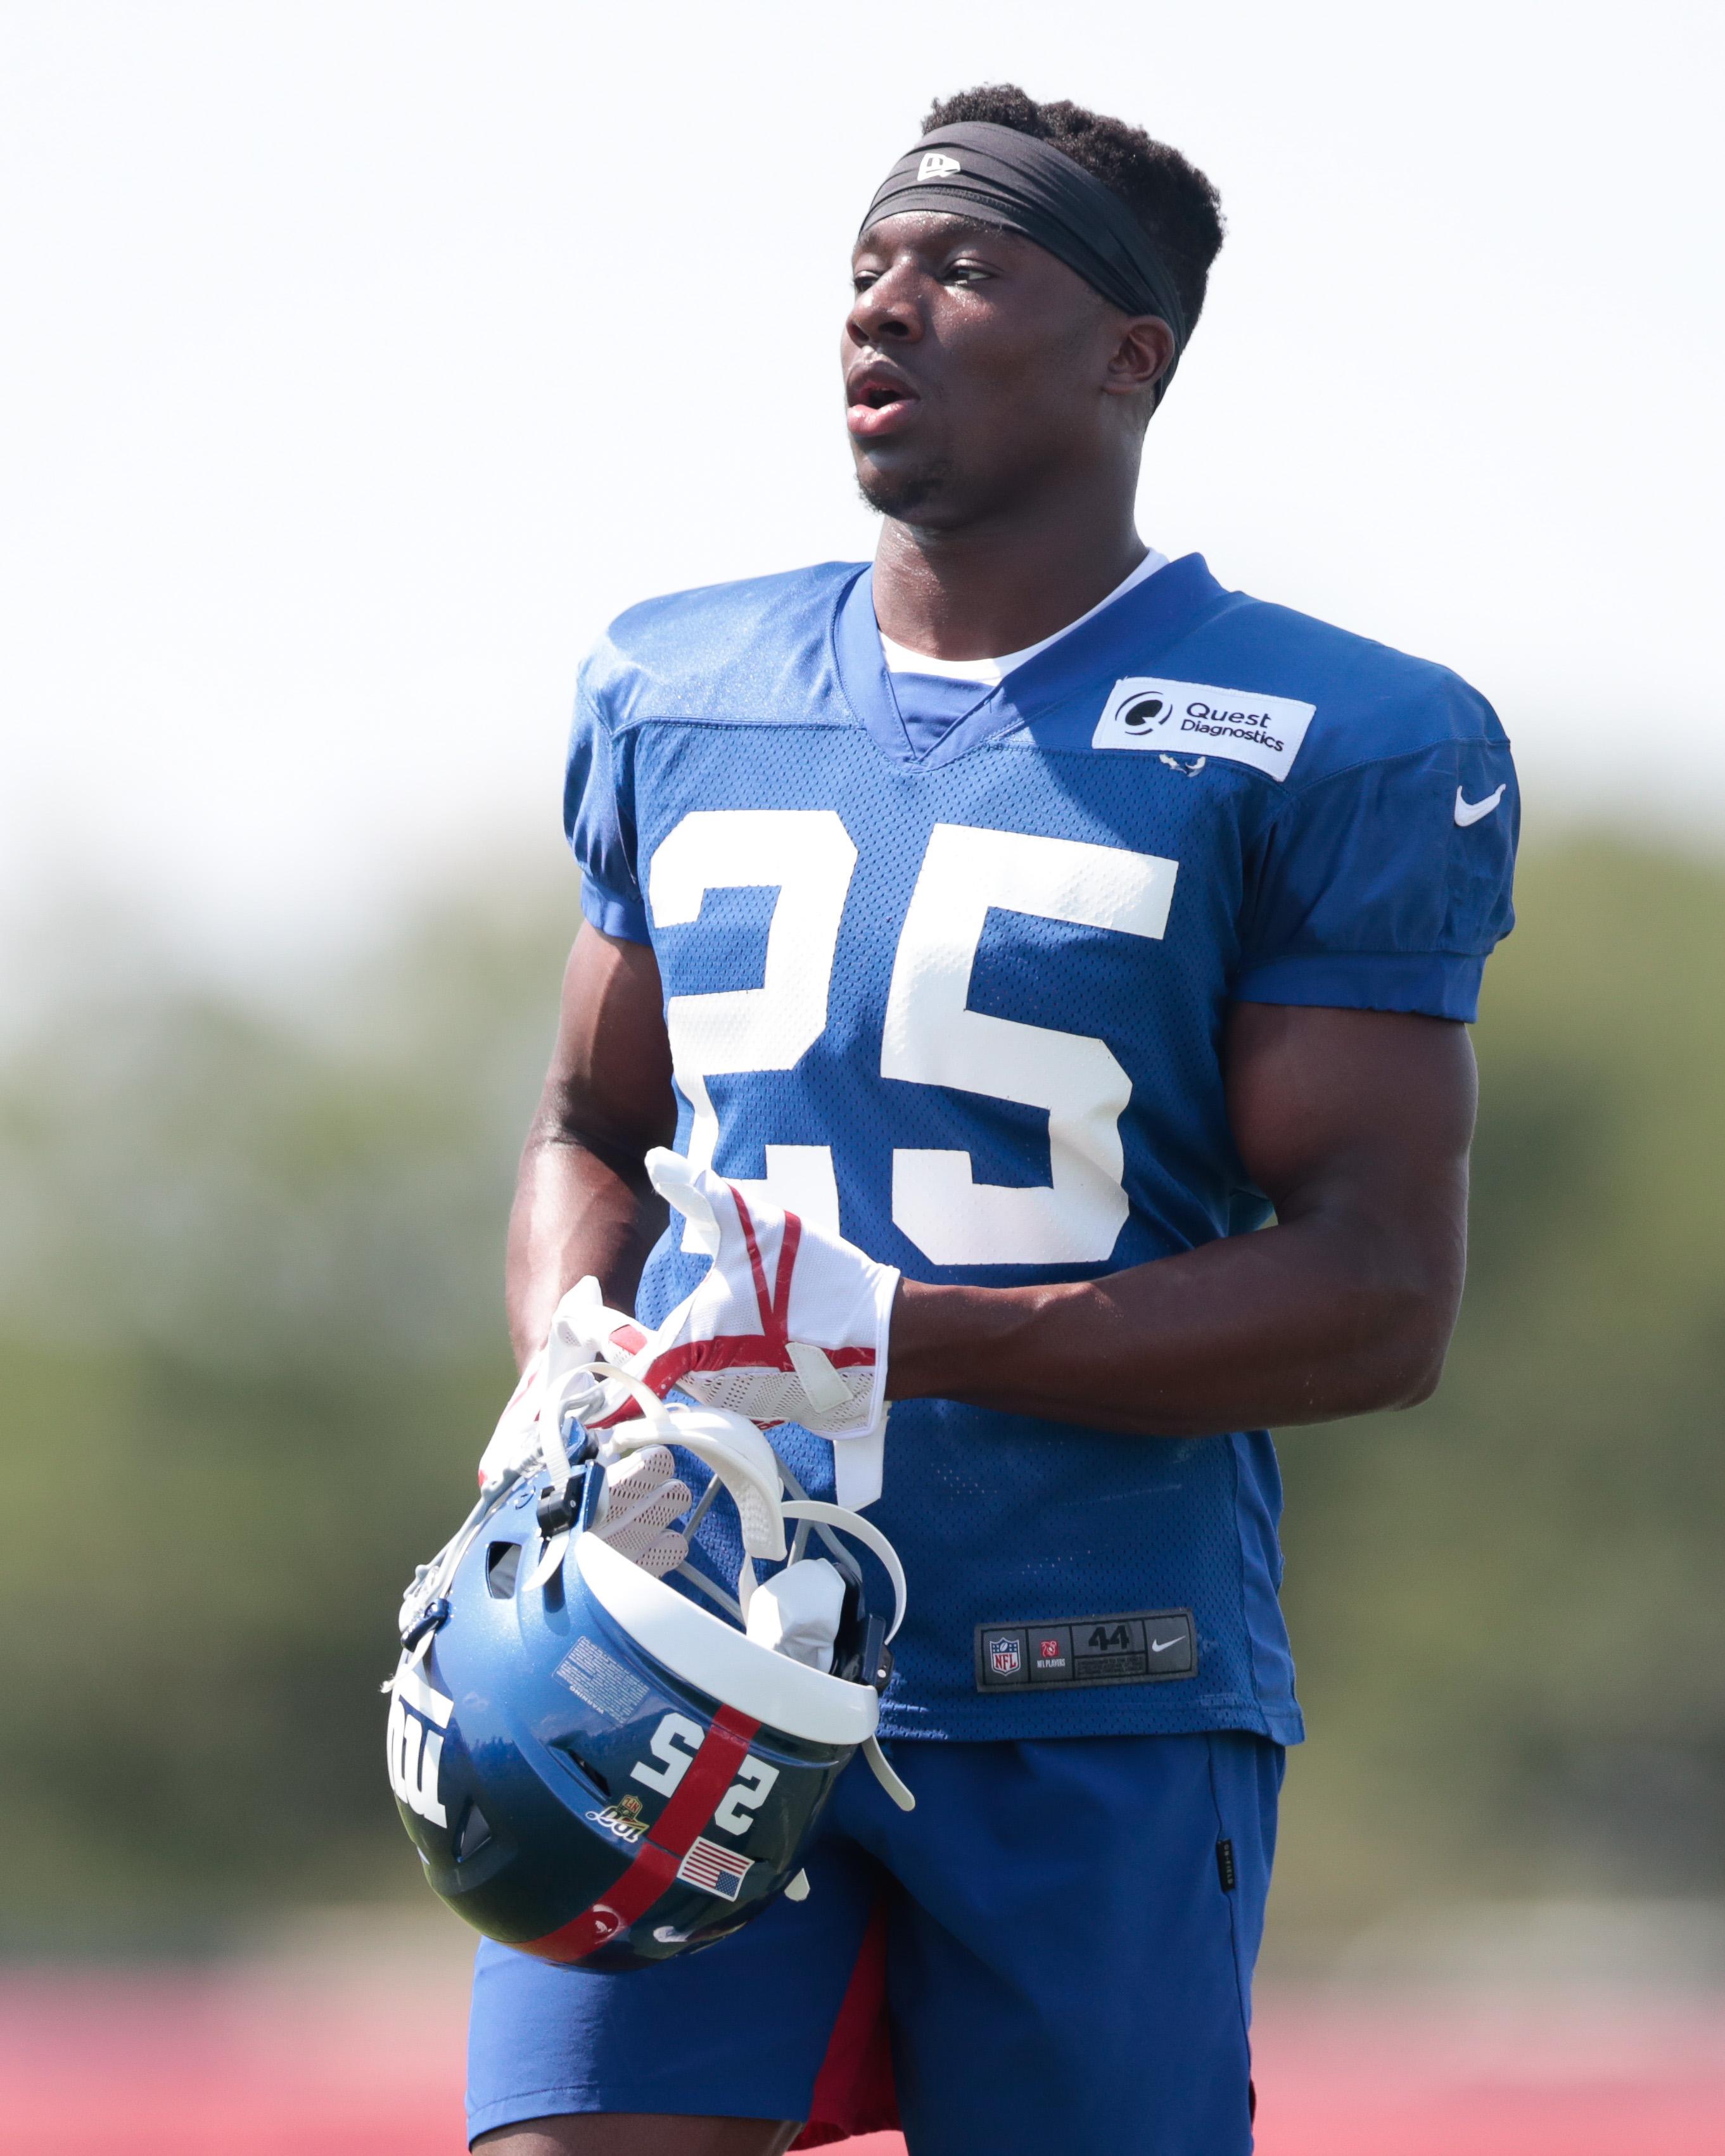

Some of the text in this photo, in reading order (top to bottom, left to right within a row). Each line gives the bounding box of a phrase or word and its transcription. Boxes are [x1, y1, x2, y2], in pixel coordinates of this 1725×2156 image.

[1186, 702, 1272, 728] Quest
[1181, 718, 1285, 752] Diagnostics
[649, 809, 1179, 1266] 25
[1088, 1624, 1130, 1651] 44
[994, 1652, 1017, 1670] NFL
[569, 1685, 604, 1715] WARNING
[623, 1797, 640, 1813] NFL
